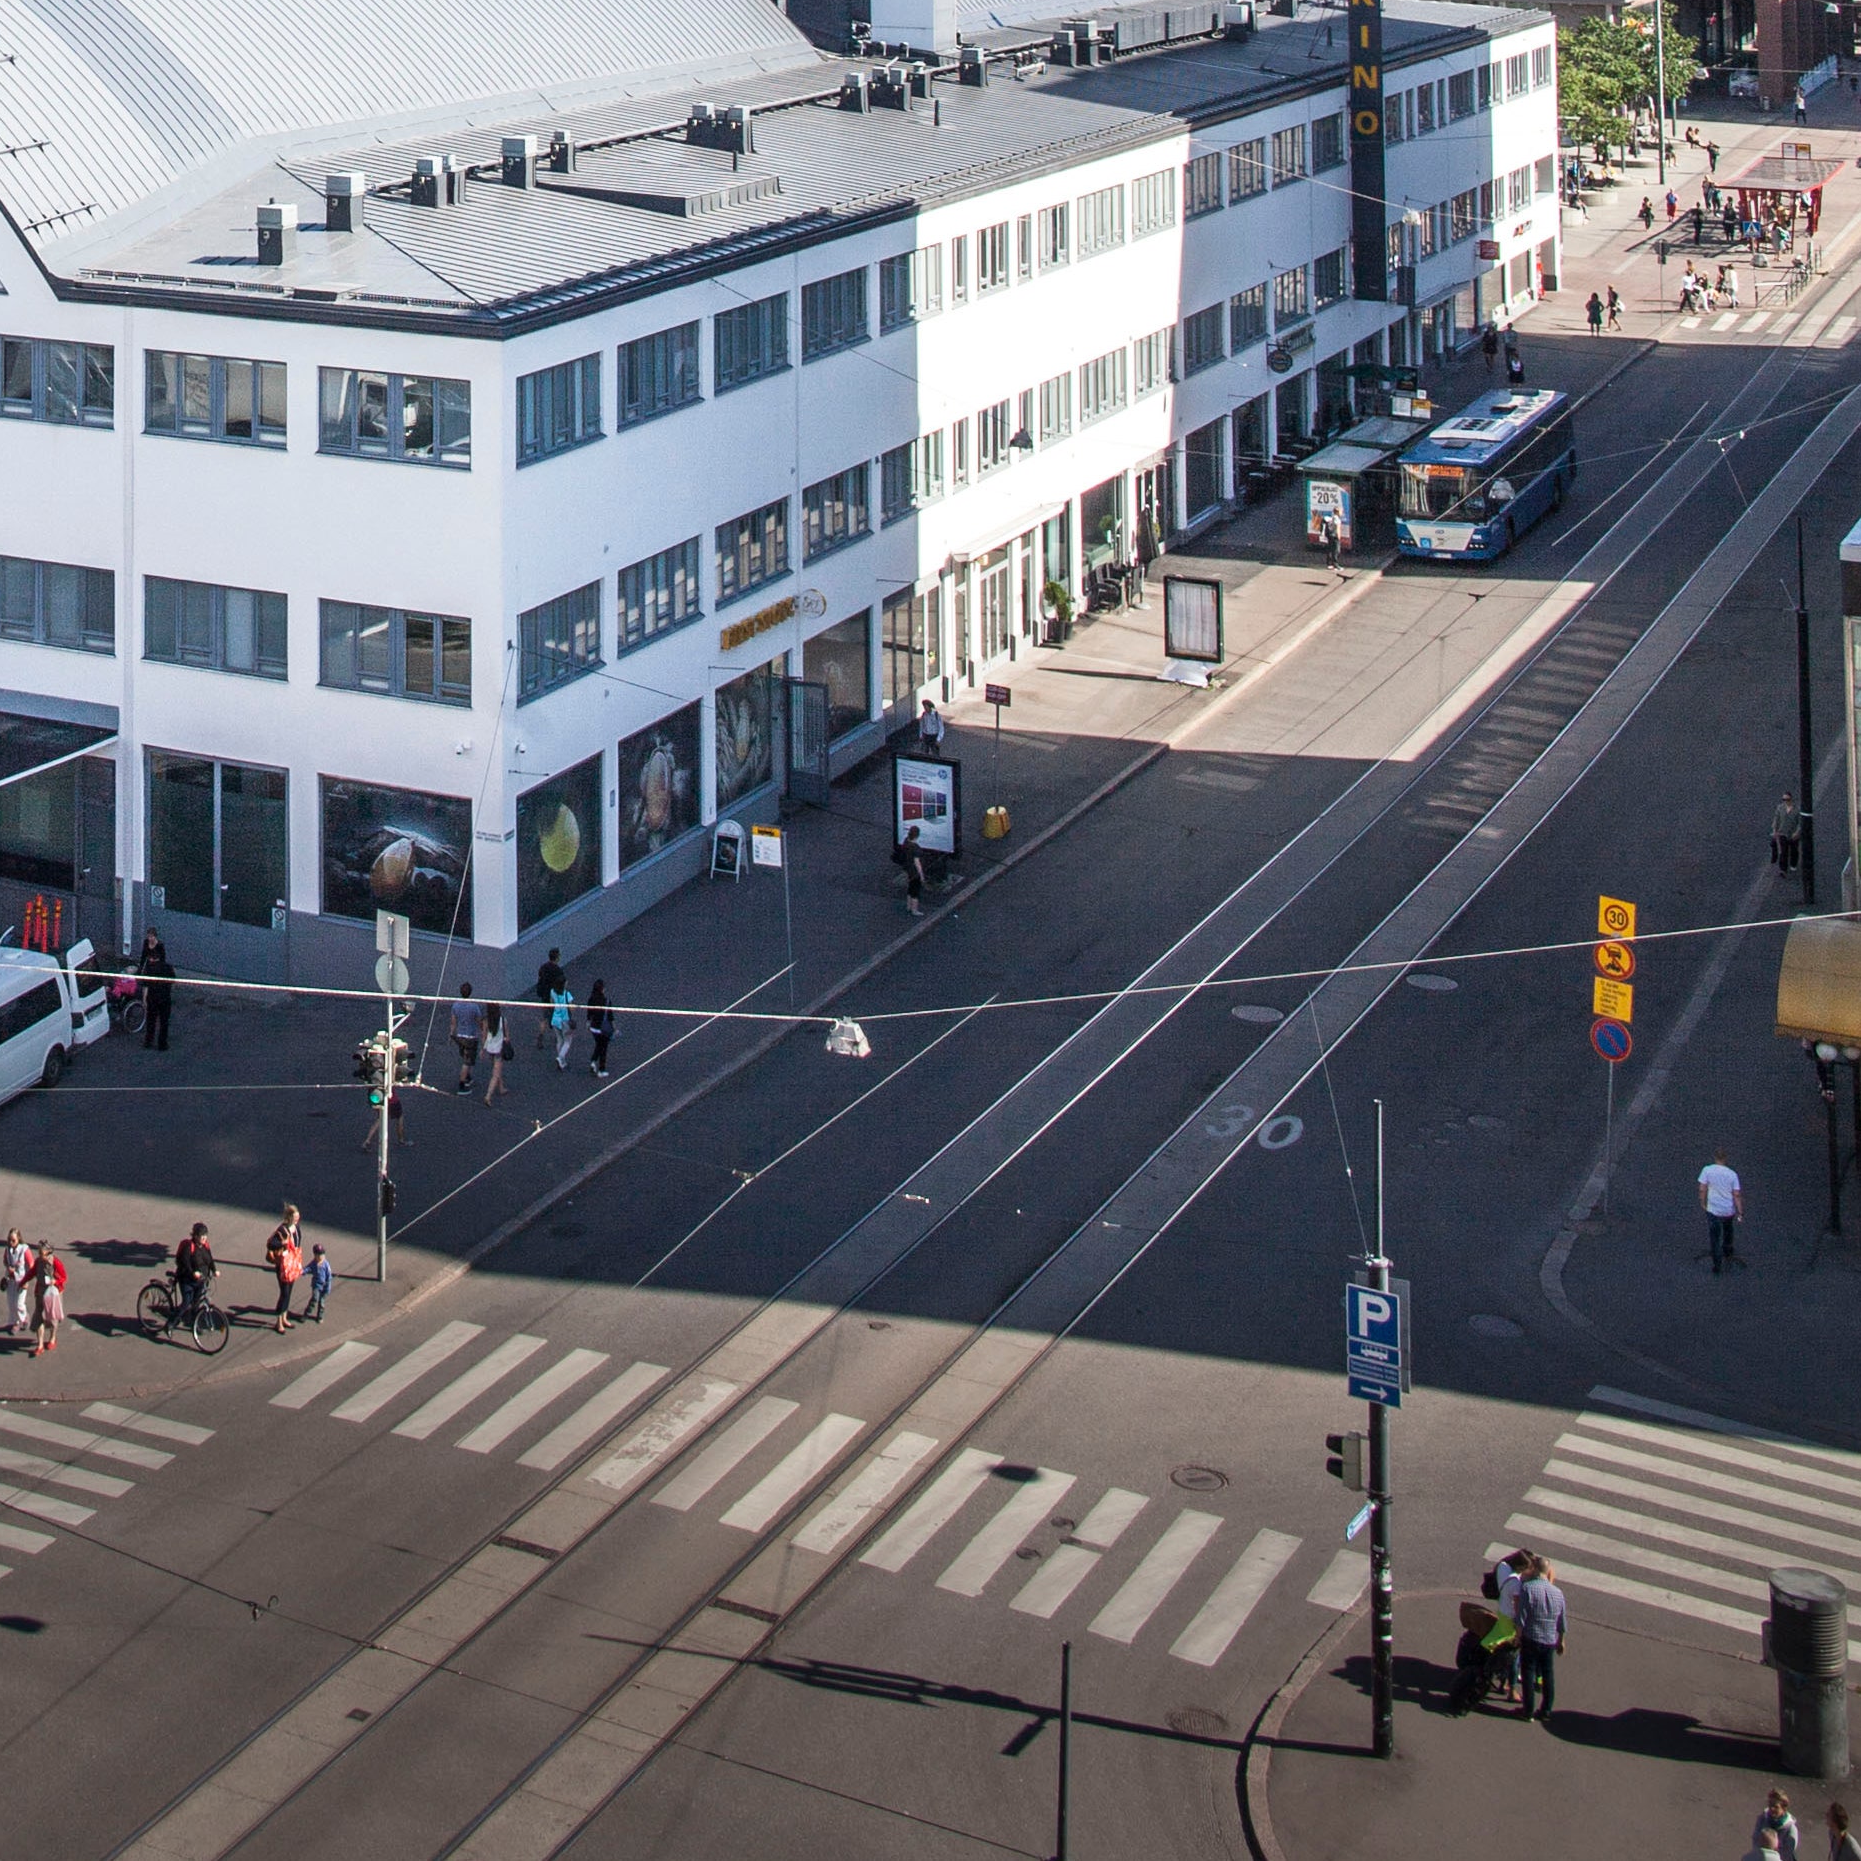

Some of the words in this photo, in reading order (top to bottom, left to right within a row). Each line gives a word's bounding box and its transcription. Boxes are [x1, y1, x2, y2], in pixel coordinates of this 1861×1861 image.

[1609, 910, 1625, 926] 30
[1205, 1104, 1304, 1150] 30
[1358, 1291, 1392, 1338] P
